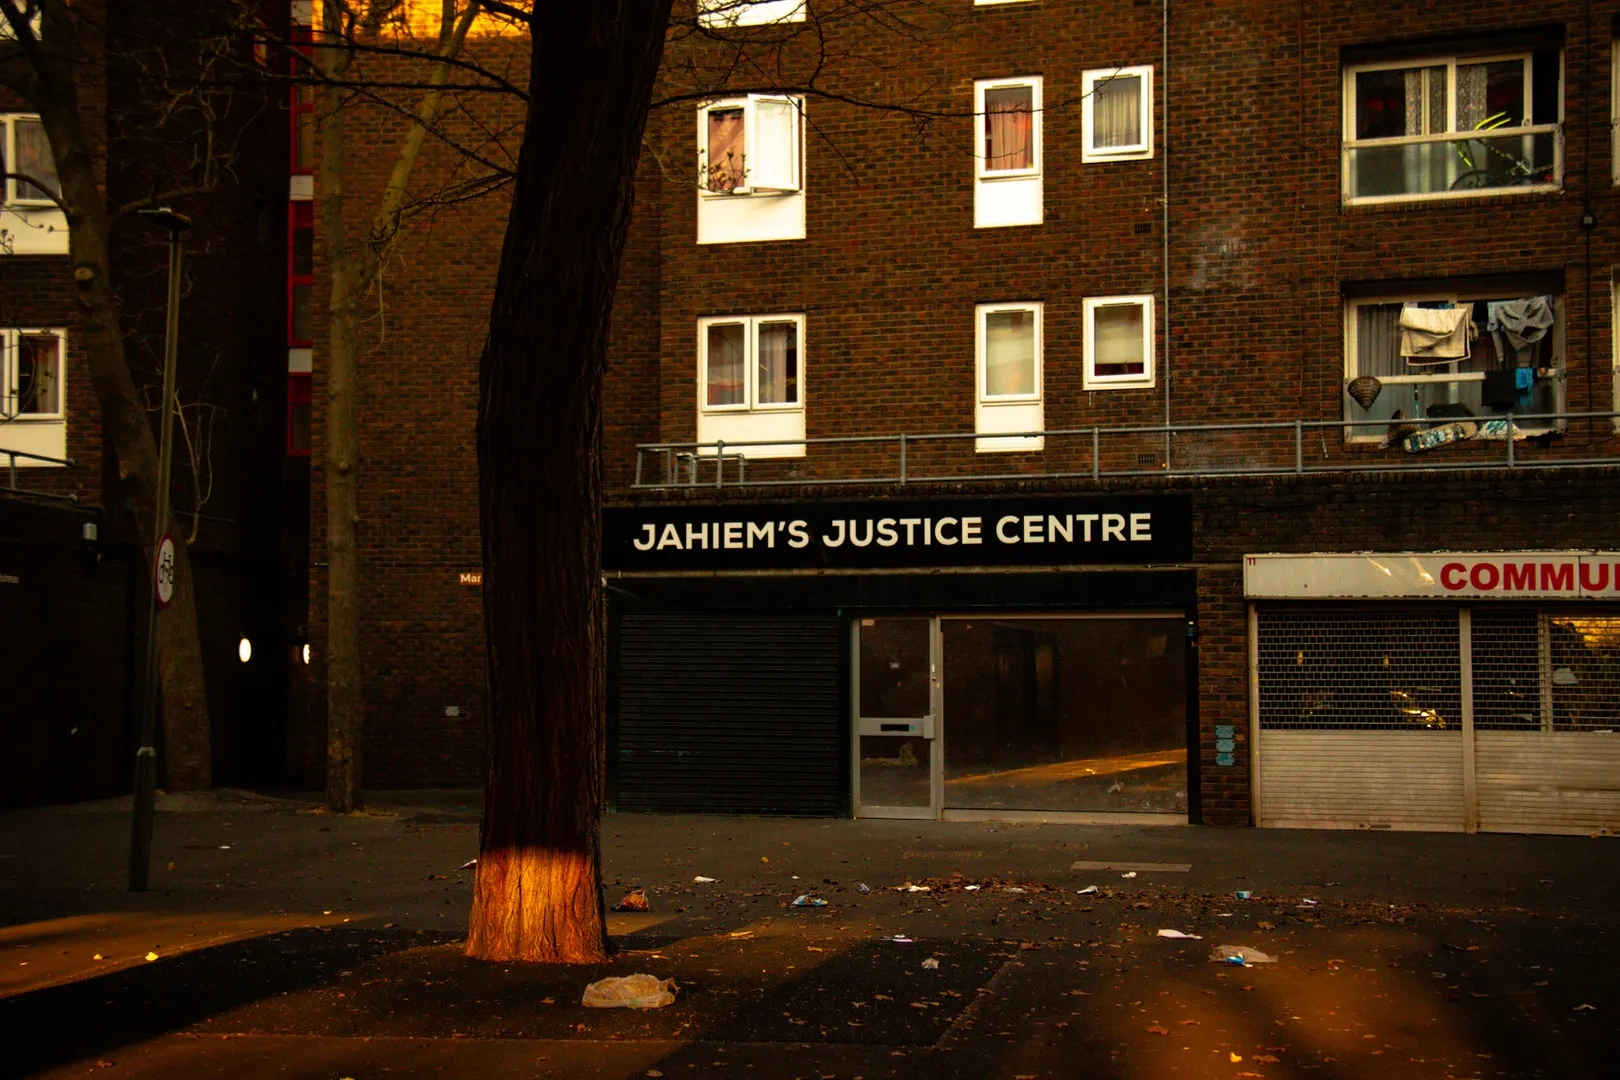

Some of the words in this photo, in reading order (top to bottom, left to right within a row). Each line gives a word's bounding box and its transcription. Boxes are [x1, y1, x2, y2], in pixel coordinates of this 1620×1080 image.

[633, 519, 810, 551] JAHIEM'S
[822, 516, 983, 548] JUSTICE
[995, 512, 1152, 544] CENTRE
[1440, 562, 1620, 591] COMMU
